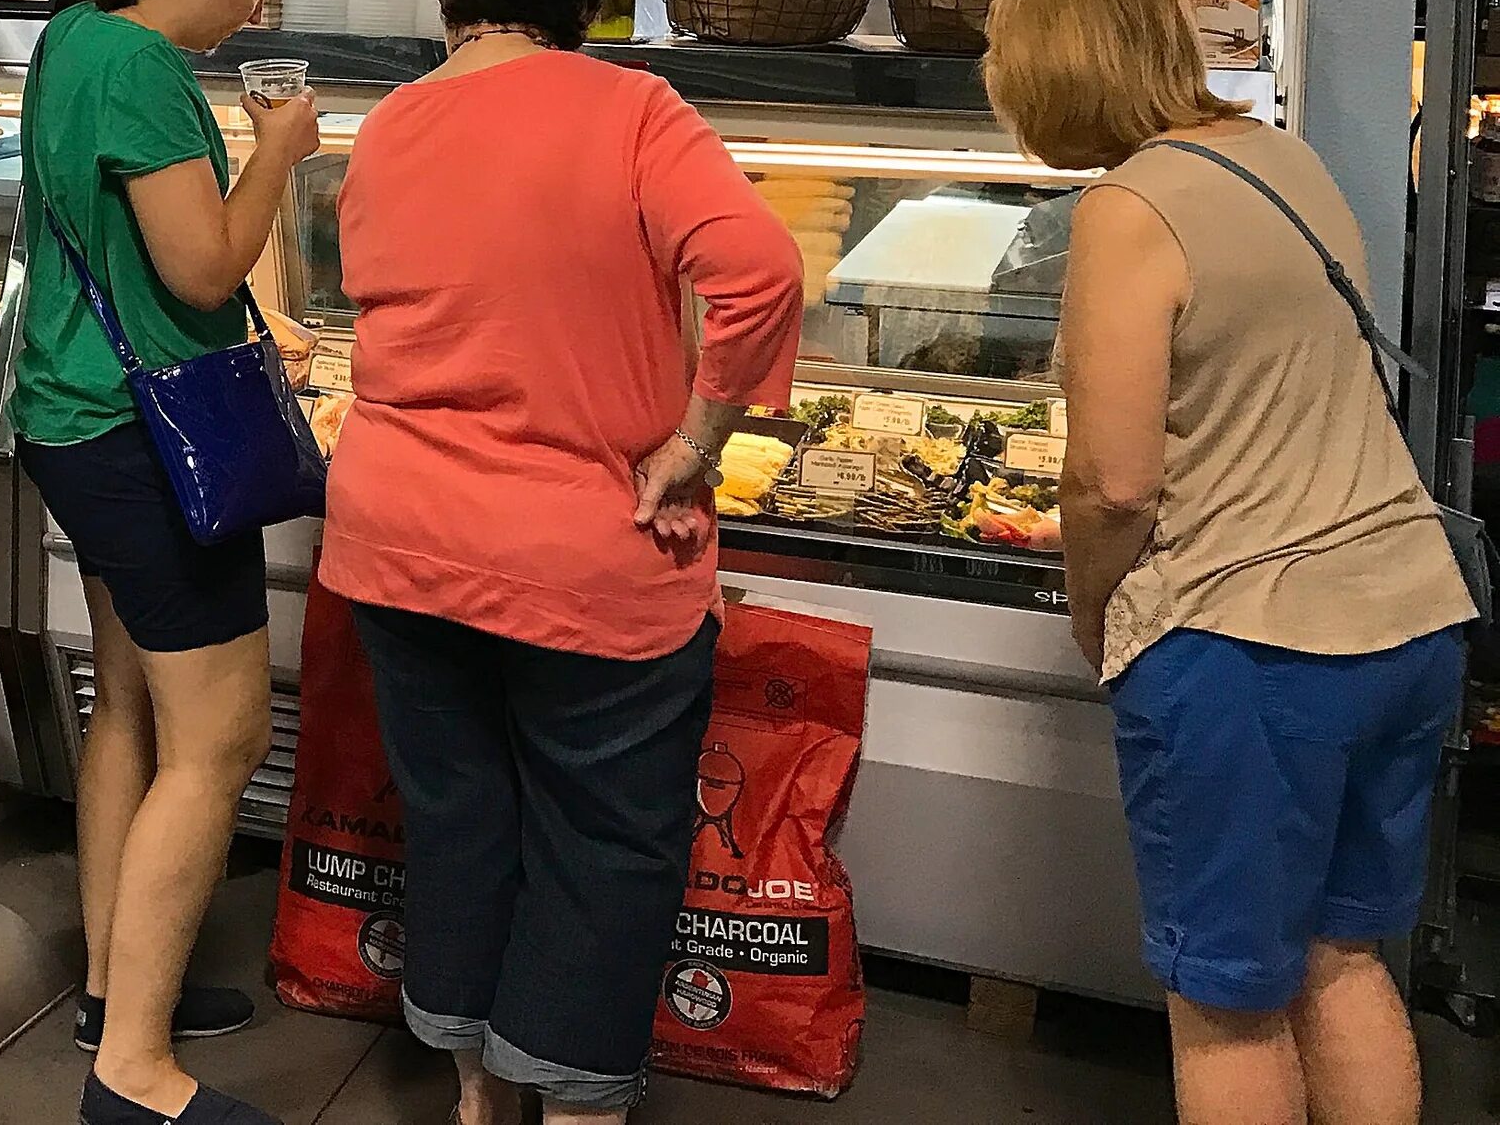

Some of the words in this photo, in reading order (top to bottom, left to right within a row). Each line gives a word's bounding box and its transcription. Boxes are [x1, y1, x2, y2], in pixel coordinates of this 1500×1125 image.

[308, 848, 366, 881] LUMP
[374, 864, 406, 890] CH
[306, 873, 378, 903] Restaurant
[675, 912, 809, 945] CHARCOAL
[687, 940, 734, 958] Grade
[750, 948, 808, 967] Organic
